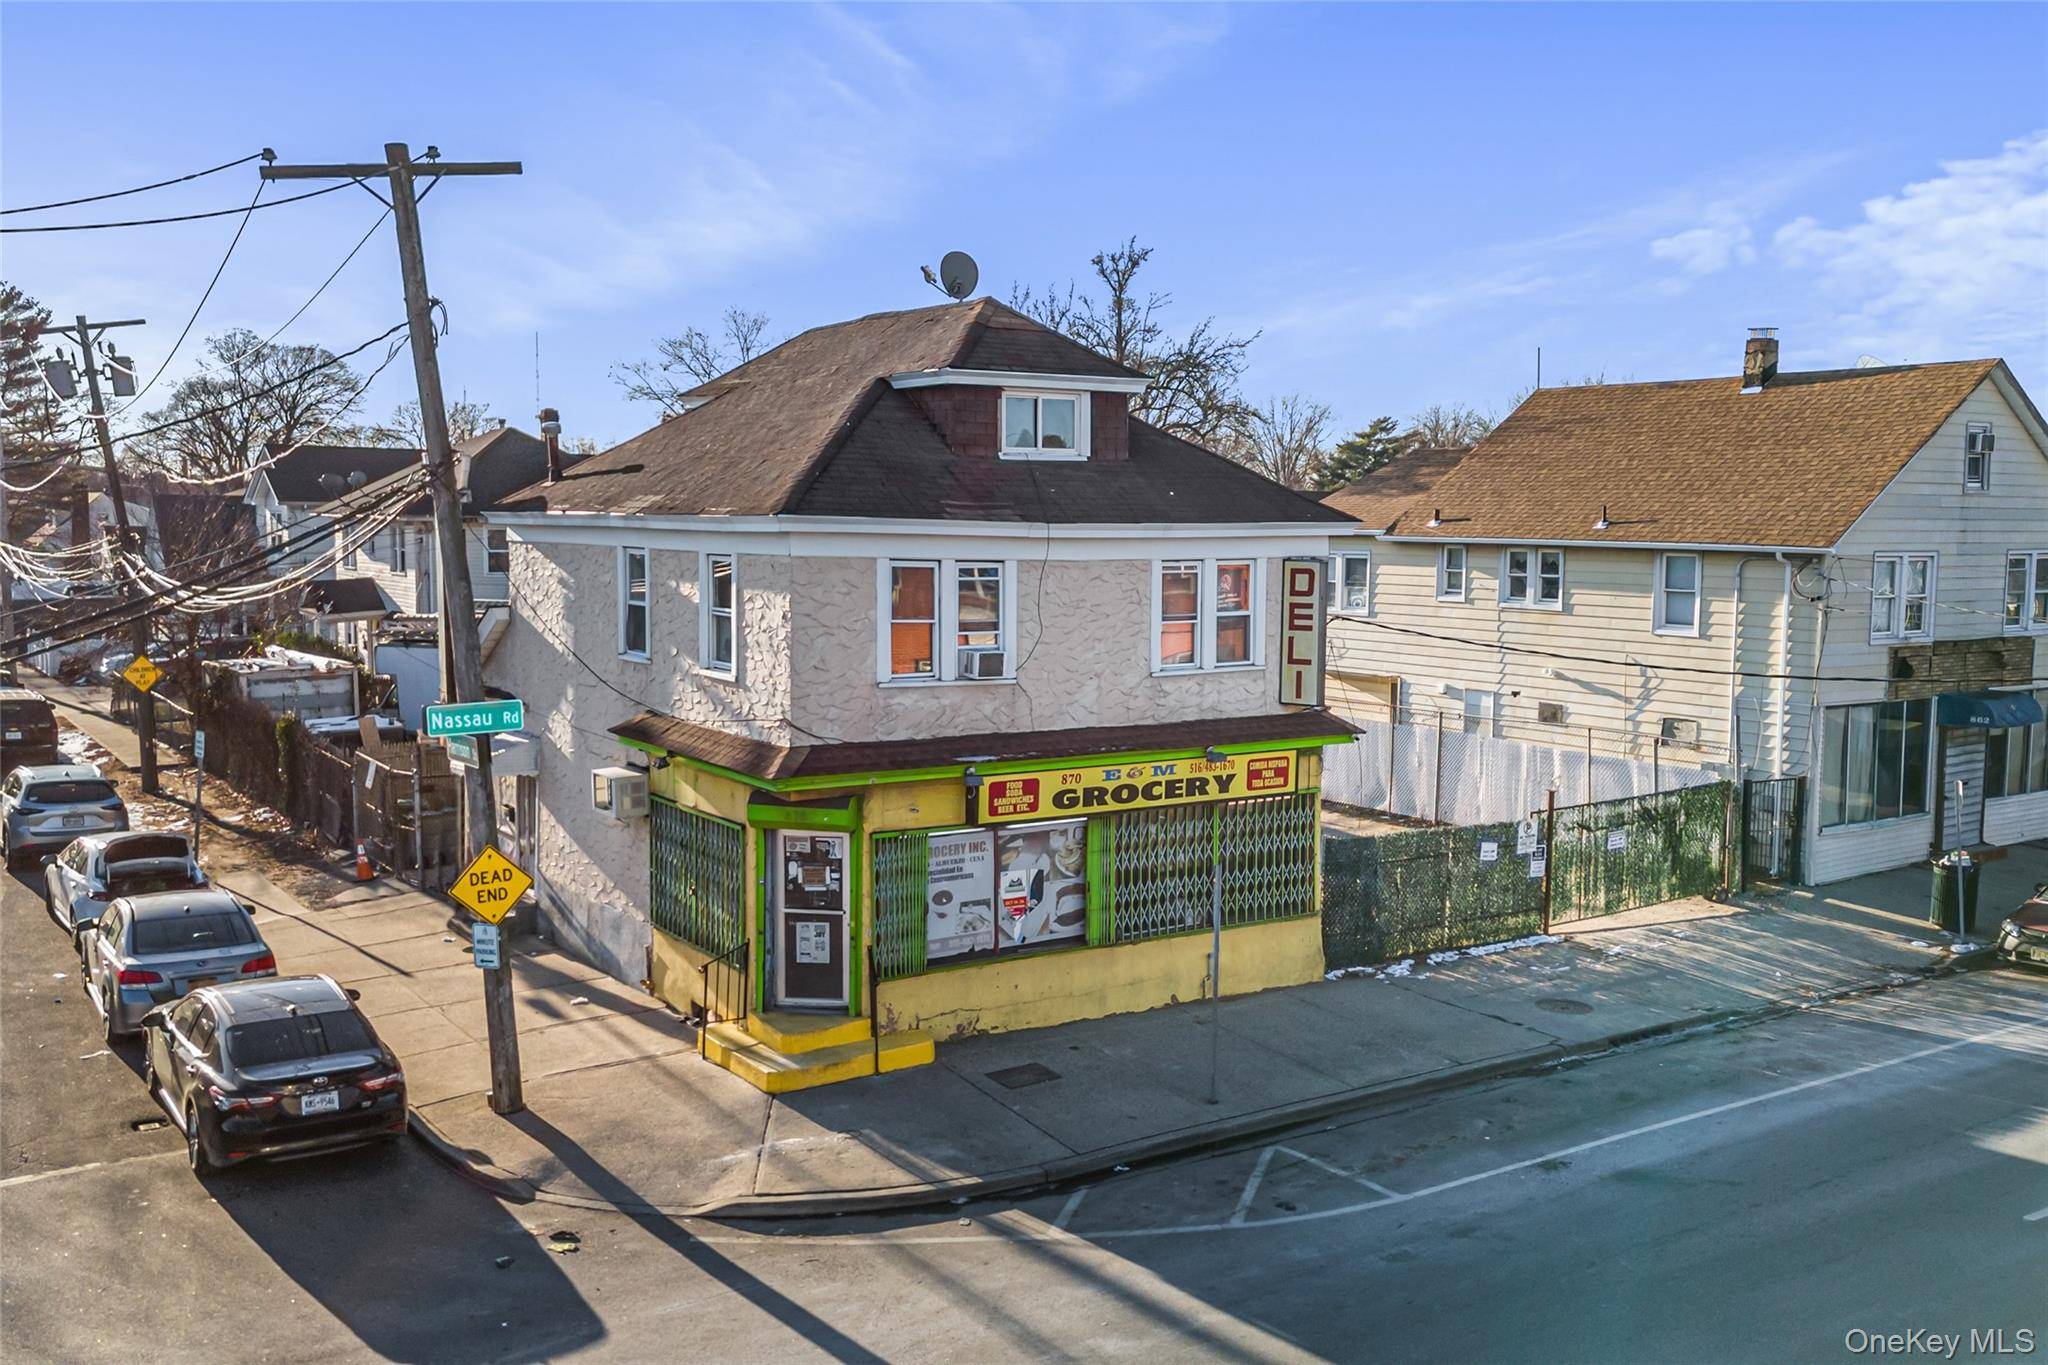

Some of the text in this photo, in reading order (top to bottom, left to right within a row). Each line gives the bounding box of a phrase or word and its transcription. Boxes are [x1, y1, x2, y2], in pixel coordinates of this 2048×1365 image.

[1287, 568, 1315, 699] DELI
[431, 711, 519, 730] Nassau Rd
[1969, 716, 1990, 724] 862
[1061, 773, 1082, 785] 870
[1102, 769, 1121, 781] E
[1151, 764, 1177, 777] M
[1006, 781, 1023, 789] FOOD
[1052, 773, 1237, 810] GROCERY
[993, 795, 1034, 806] SANDWICHES
[969, 841, 989, 853] INC.
[470, 868, 513, 887] DEAD
[477, 887, 508, 904] END
